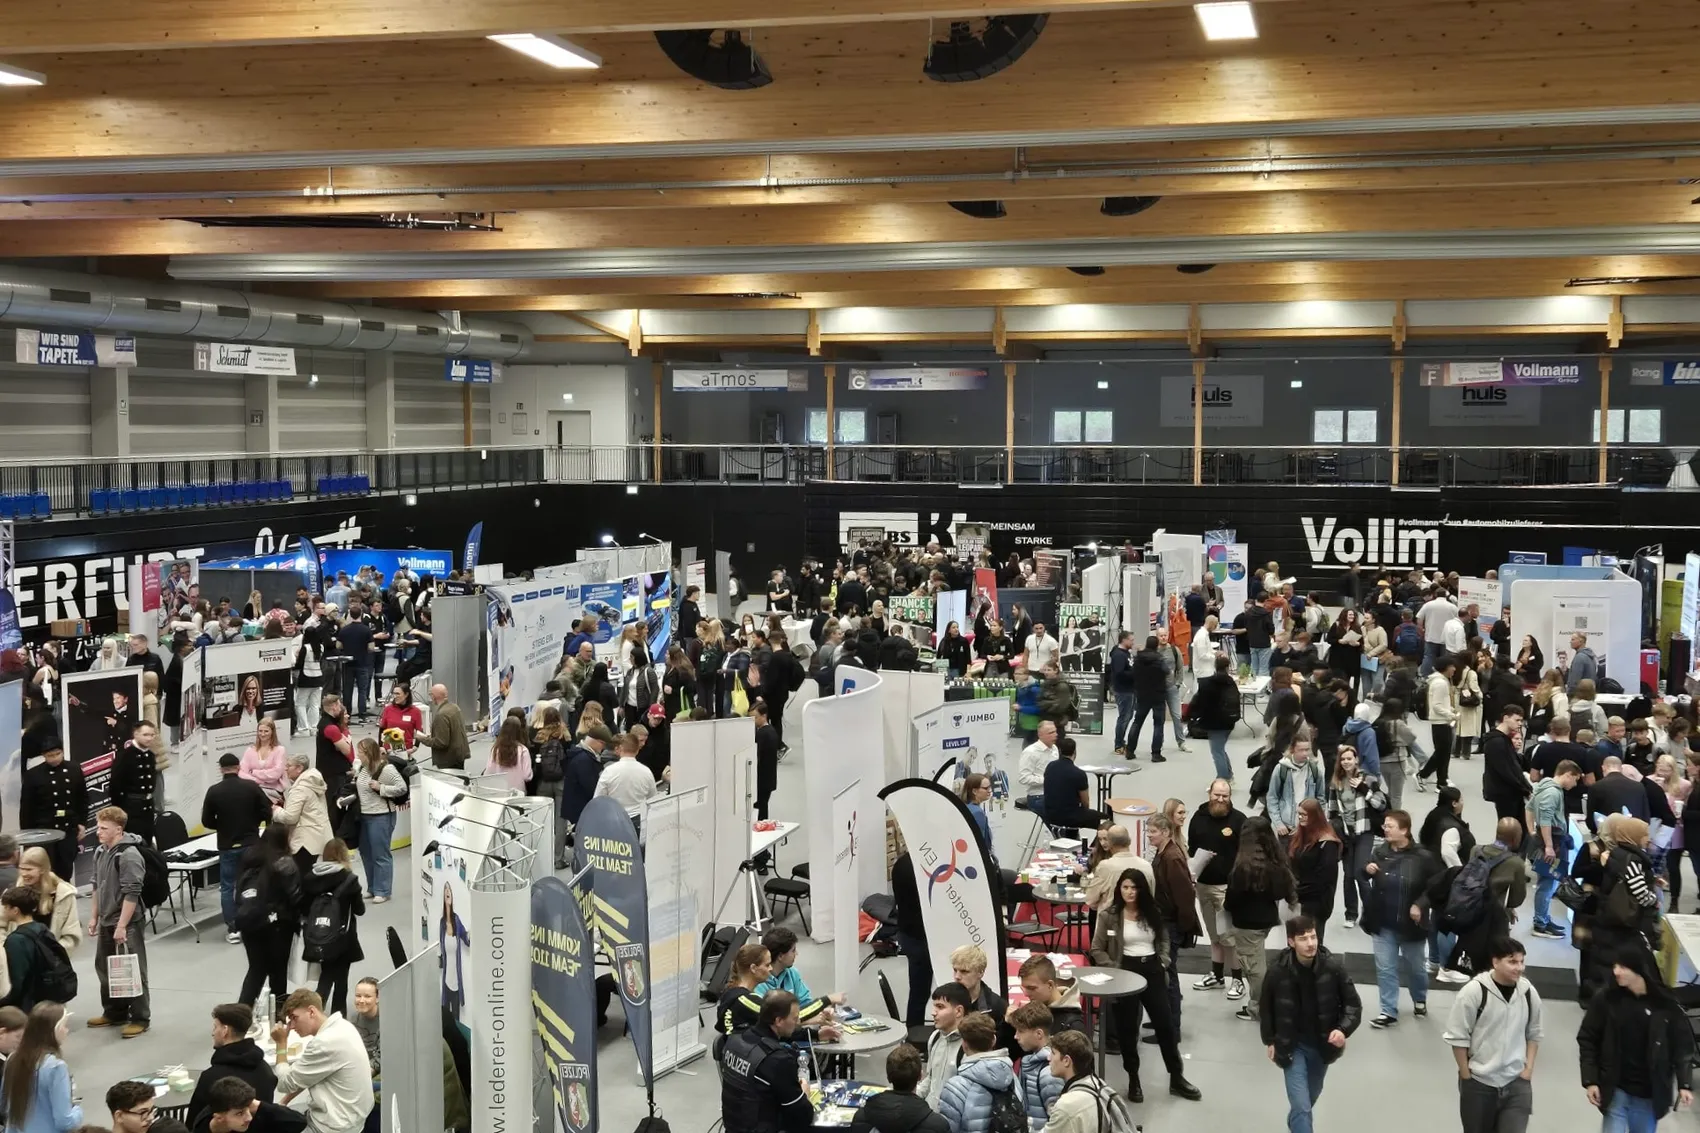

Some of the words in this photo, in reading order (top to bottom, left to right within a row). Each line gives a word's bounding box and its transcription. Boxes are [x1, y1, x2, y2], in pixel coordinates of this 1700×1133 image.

[41, 333, 59, 345] WIR
[60, 335, 80, 347] SIND
[40, 347, 82, 365] TAPETE.
[198, 351, 207, 371] H
[216, 345, 252, 367] Schmidt
[1514, 364, 1579, 377] Vollmann
[1632, 368, 1660, 379] Rang
[701, 372, 757, 387] aTmos
[852, 375, 866, 389] G
[1427, 371, 1437, 386] F
[1015, 537, 1053, 545] STARKE
[397, 557, 446, 570] Vollmann
[889, 598, 925, 608] CHANCE
[1060, 605, 1099, 616] FUTURE
[966, 713, 995, 723] JUMBO
[724, 1008, 734, 1036] NRW
[724, 1049, 751, 1078] POLIZEI
